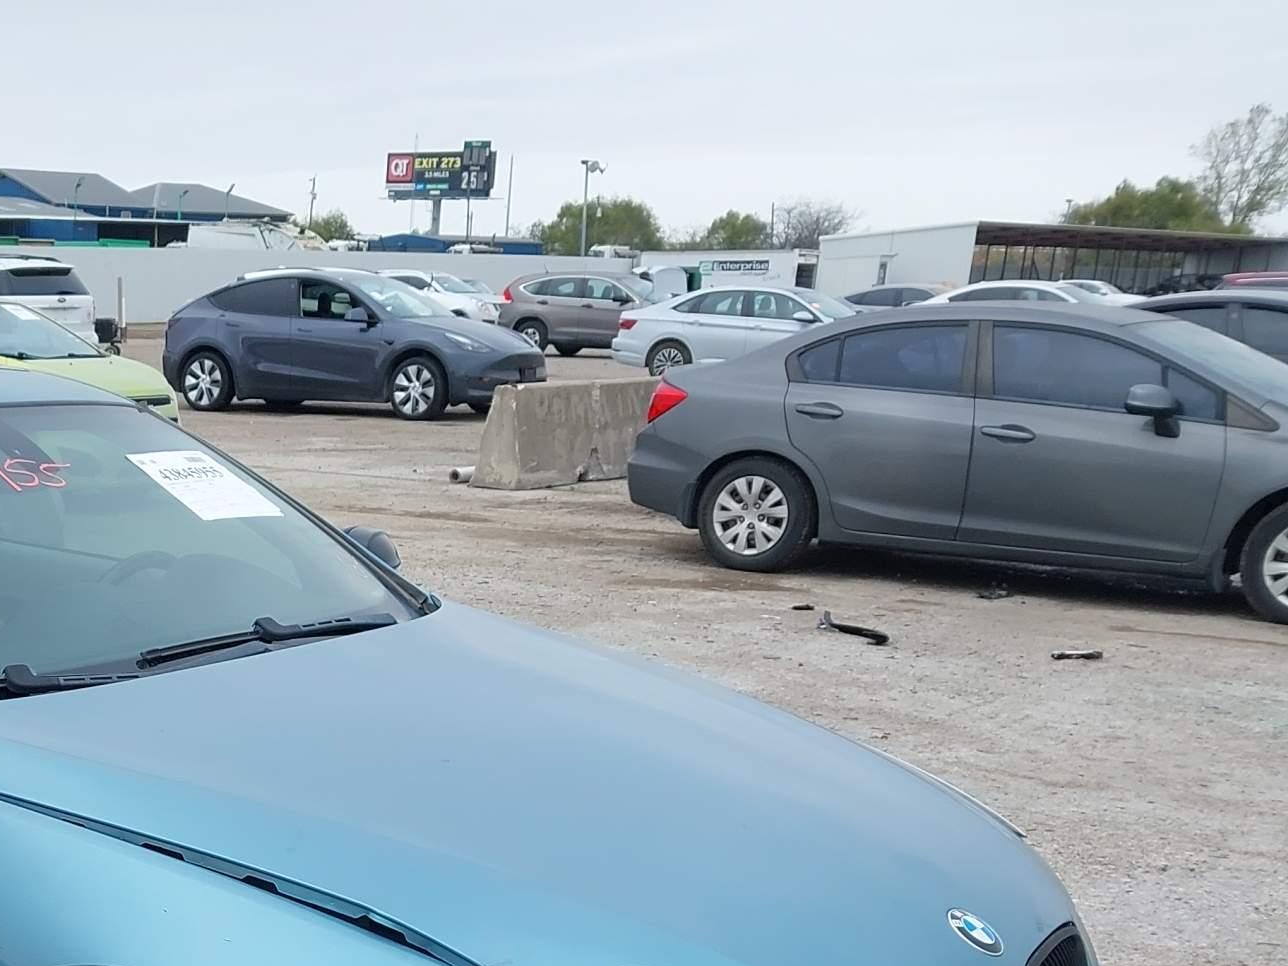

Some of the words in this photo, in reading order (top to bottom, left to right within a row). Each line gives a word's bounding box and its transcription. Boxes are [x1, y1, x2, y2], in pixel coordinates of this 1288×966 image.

[392, 159, 409, 177] QT
[415, 158, 439, 168] EXIT
[440, 157, 461, 168] 273
[713, 261, 769, 272] Enterprise
